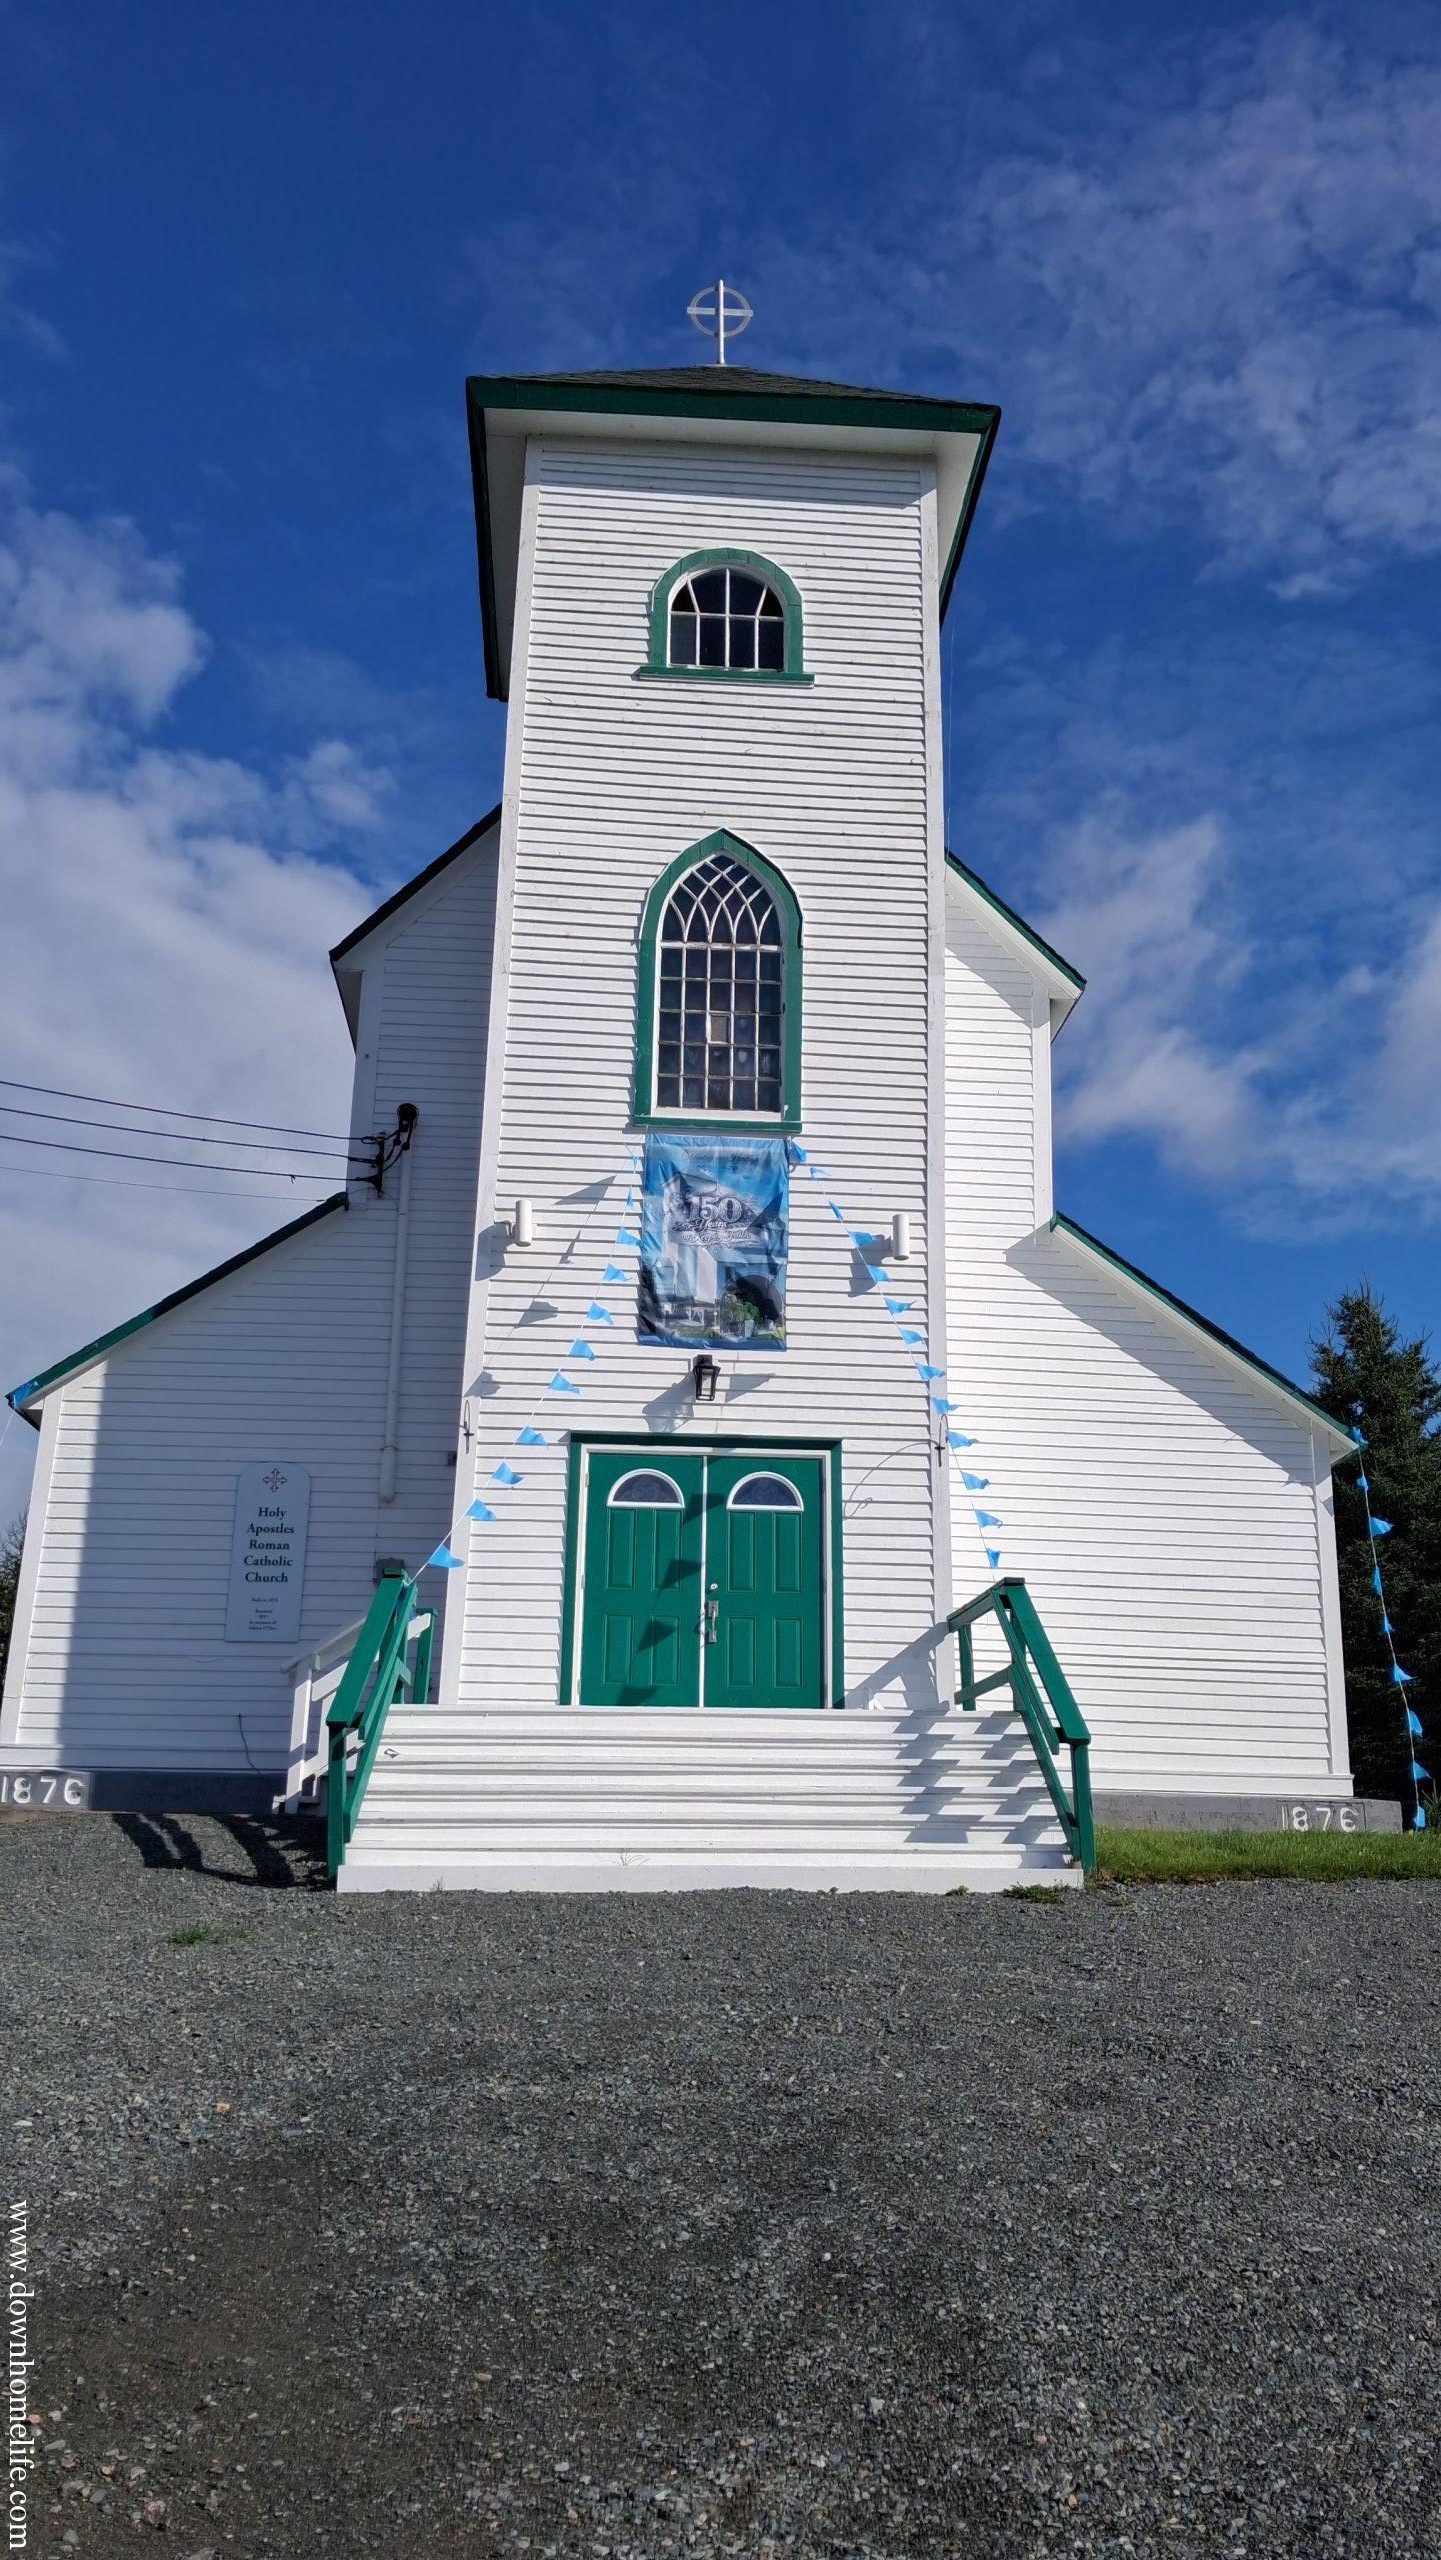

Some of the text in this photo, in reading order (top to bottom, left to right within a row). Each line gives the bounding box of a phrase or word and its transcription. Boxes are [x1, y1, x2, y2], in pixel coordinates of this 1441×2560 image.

[685, 1195, 742, 1223] 150
[258, 1506, 287, 1521] Holy
[247, 1522, 295, 1536] Apostles
[249, 1539, 290, 1550] Roman
[243, 1555, 293, 1567] Catholic
[245, 1571, 288, 1583] Church
[2, 1775, 86, 1805] 1876
[1281, 1804, 1359, 1832] 1876
